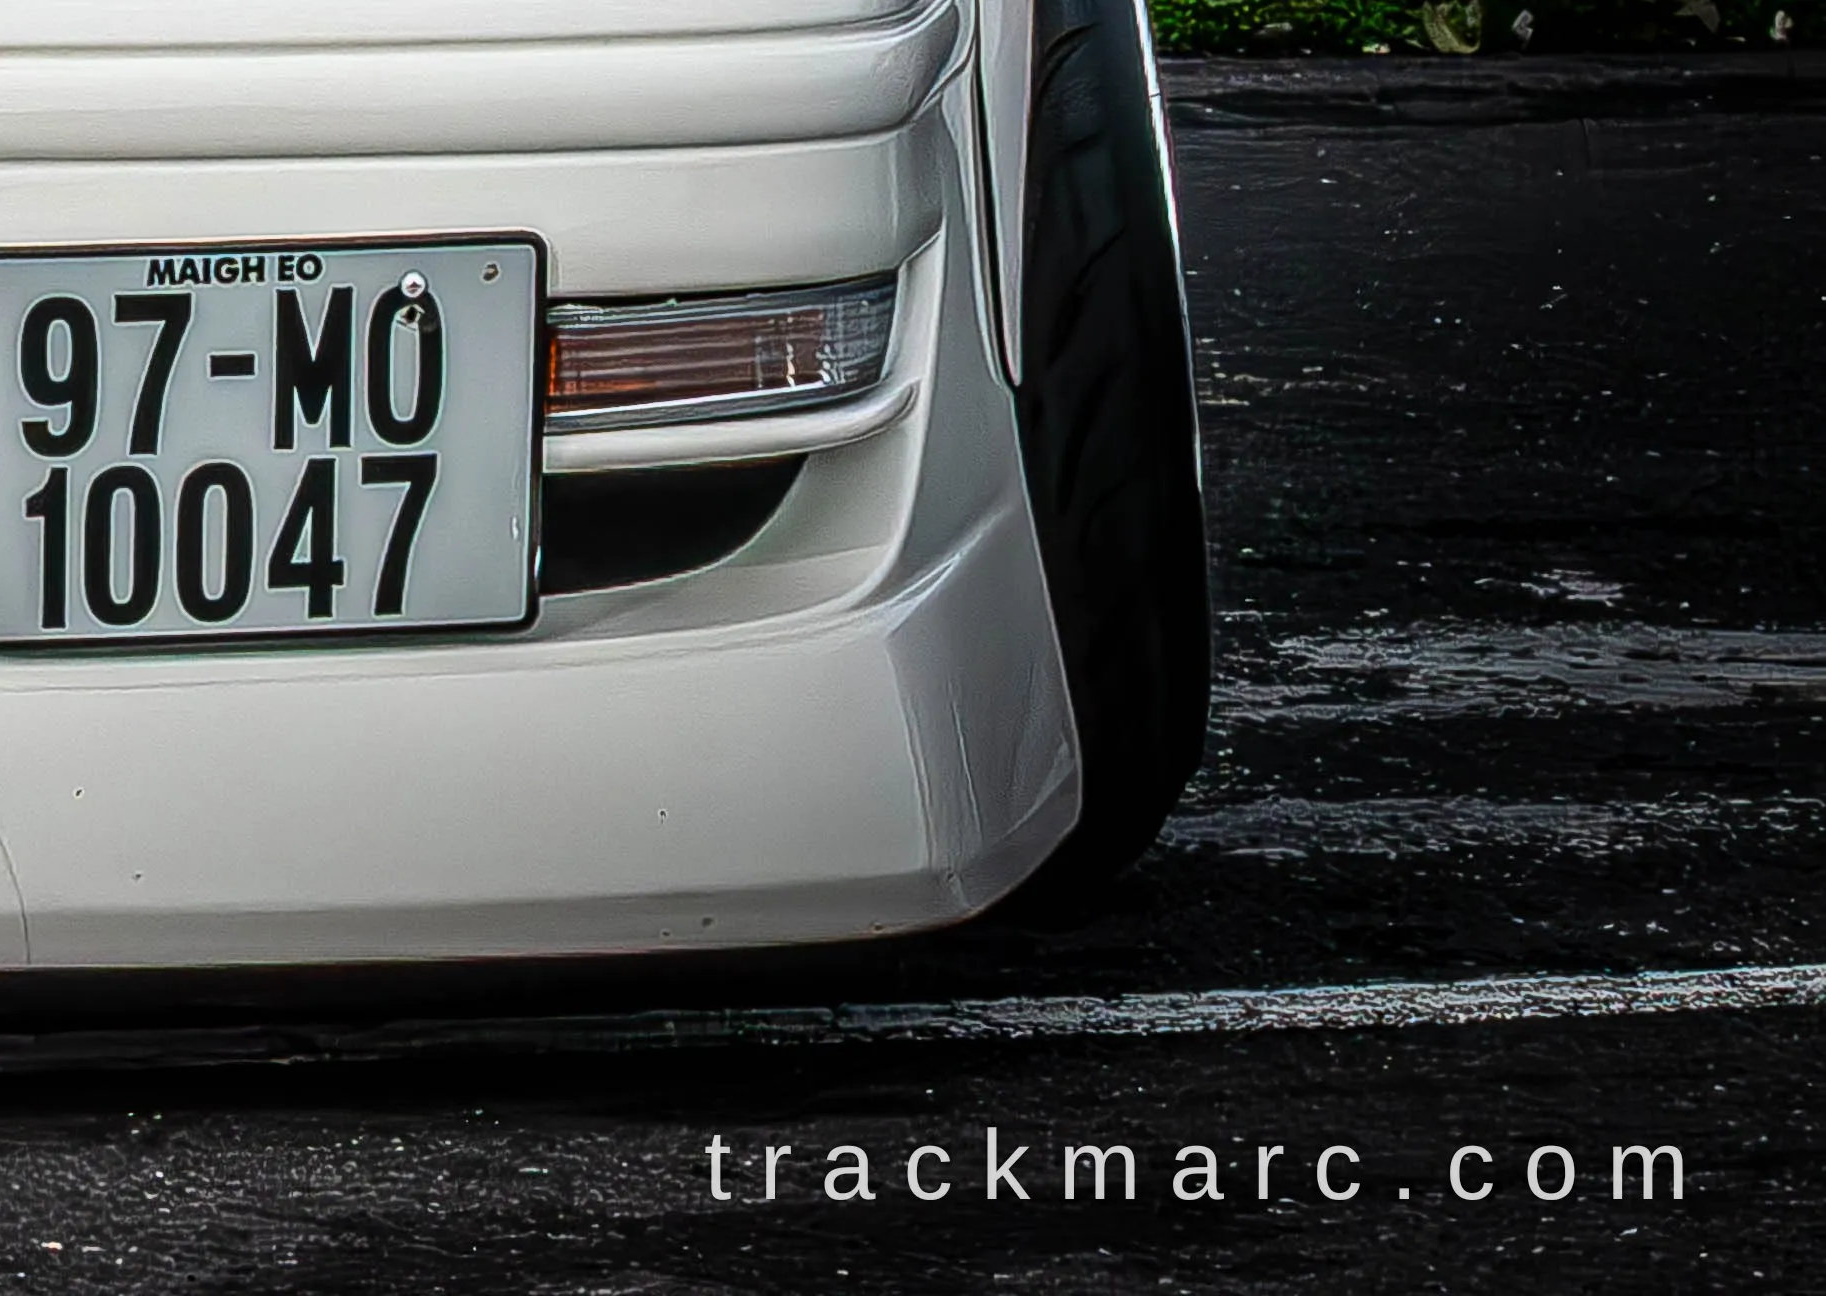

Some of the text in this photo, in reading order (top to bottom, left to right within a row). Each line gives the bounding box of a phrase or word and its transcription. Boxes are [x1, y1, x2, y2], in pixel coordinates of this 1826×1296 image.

[147, 253, 324, 287] MAIGH EO
[24, 453, 440, 631] 10047
